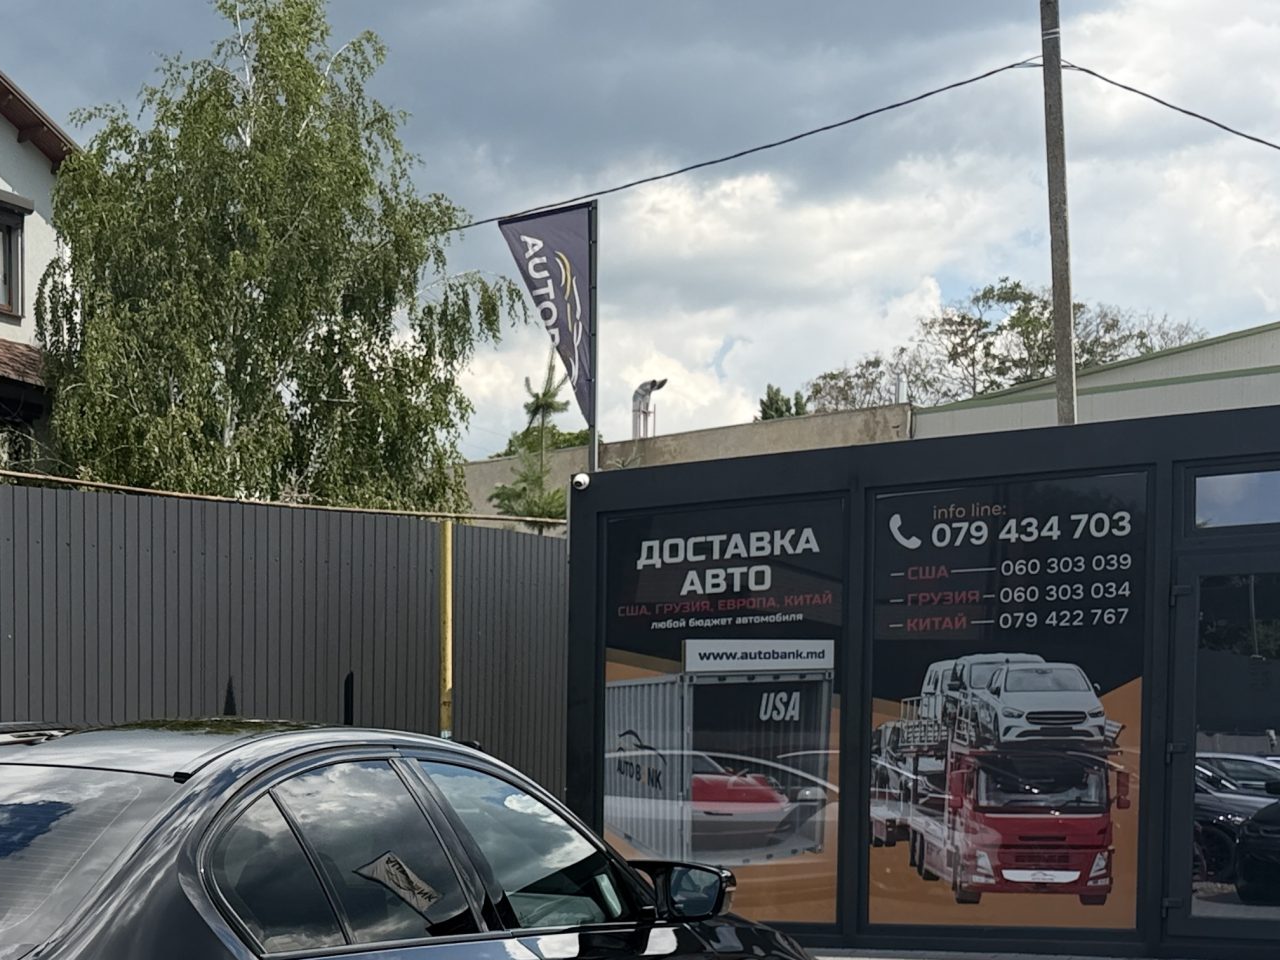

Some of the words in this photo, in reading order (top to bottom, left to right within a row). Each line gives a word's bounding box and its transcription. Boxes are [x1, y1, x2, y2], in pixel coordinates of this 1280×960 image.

[932, 504, 966, 520] info
[970, 502, 1007, 518] line:
[931, 520, 989, 548] 079
[998, 515, 1061, 543] 434
[1070, 511, 1132, 539] 703
[636, 527, 820, 570] ДОСТАВКА
[907, 565, 949, 580] США
[1000, 558, 1041, 576] 060
[1046, 556, 1086, 574] 303
[1091, 553, 1132, 571] 039
[680, 565, 772, 596] АВТО
[784, 591, 833, 606] КИТАЙ
[907, 590, 980, 606] ГРУЗИЯ
[999, 586, 1039, 603] 060
[1045, 583, 1084, 601] 303
[1090, 581, 1132, 599] 034
[650, 619, 686, 630] любой
[688, 616, 733, 628] бюджет
[735, 613, 804, 625] автомобиля
[906, 612, 967, 631] КИТАЙ
[999, 611, 1038, 629] 079
[1045, 609, 1084, 627] 422
[1090, 607, 1129, 625] 767
[698, 649, 826, 661] www.autobank.md
[758, 691, 801, 721] USA
